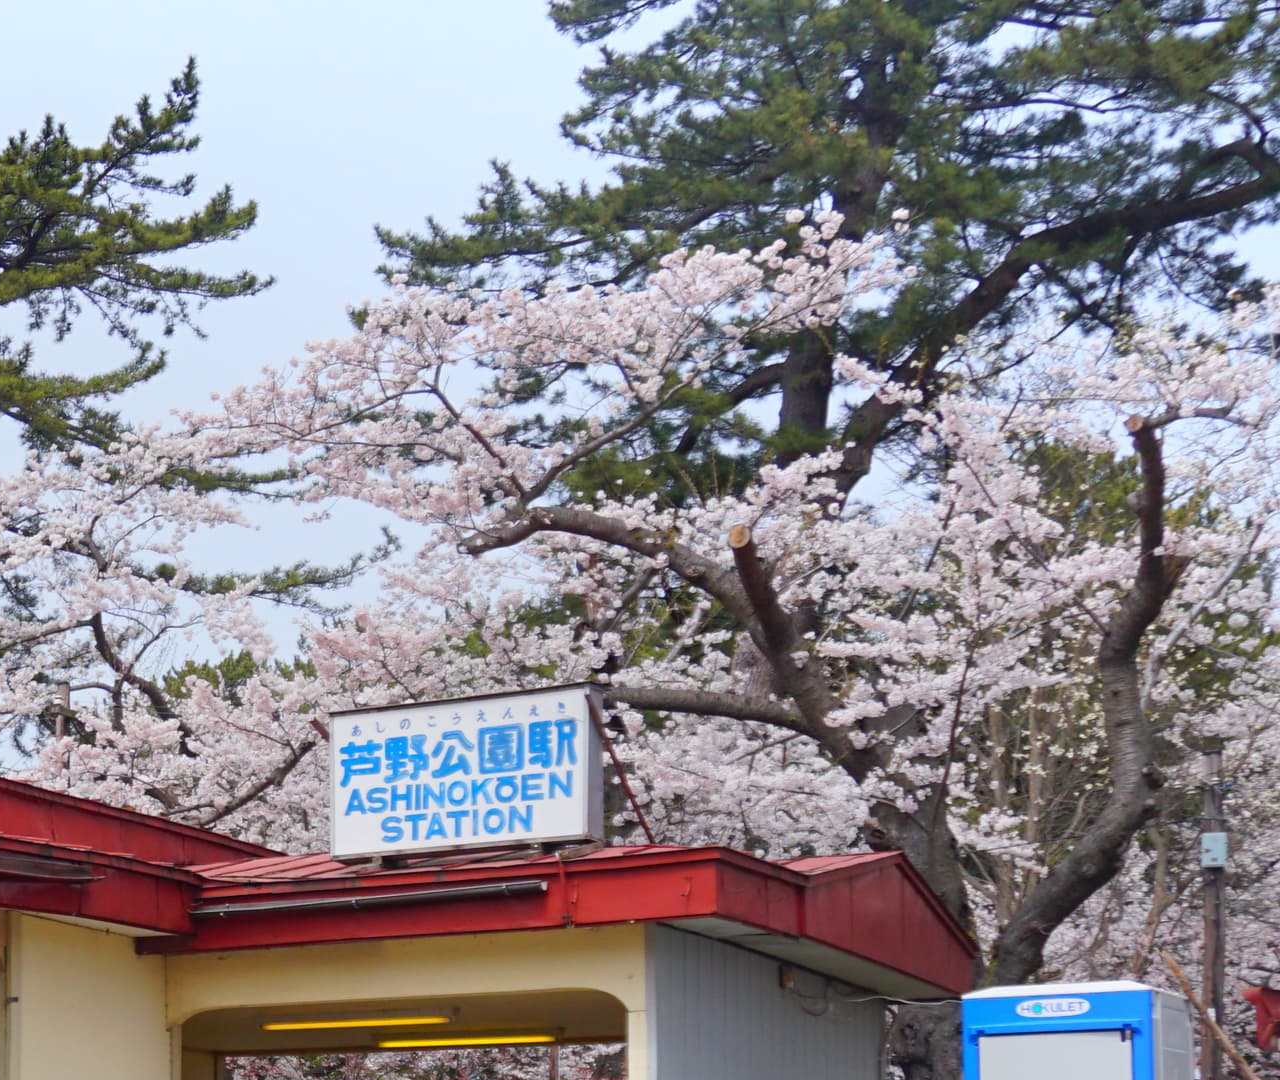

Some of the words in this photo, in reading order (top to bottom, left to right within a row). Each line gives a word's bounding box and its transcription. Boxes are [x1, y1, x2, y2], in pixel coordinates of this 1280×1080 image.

[351, 701, 567, 736] あしのこうえんえき
[340, 718, 578, 787] 芦野公園駅
[380, 804, 534, 843] STATION
